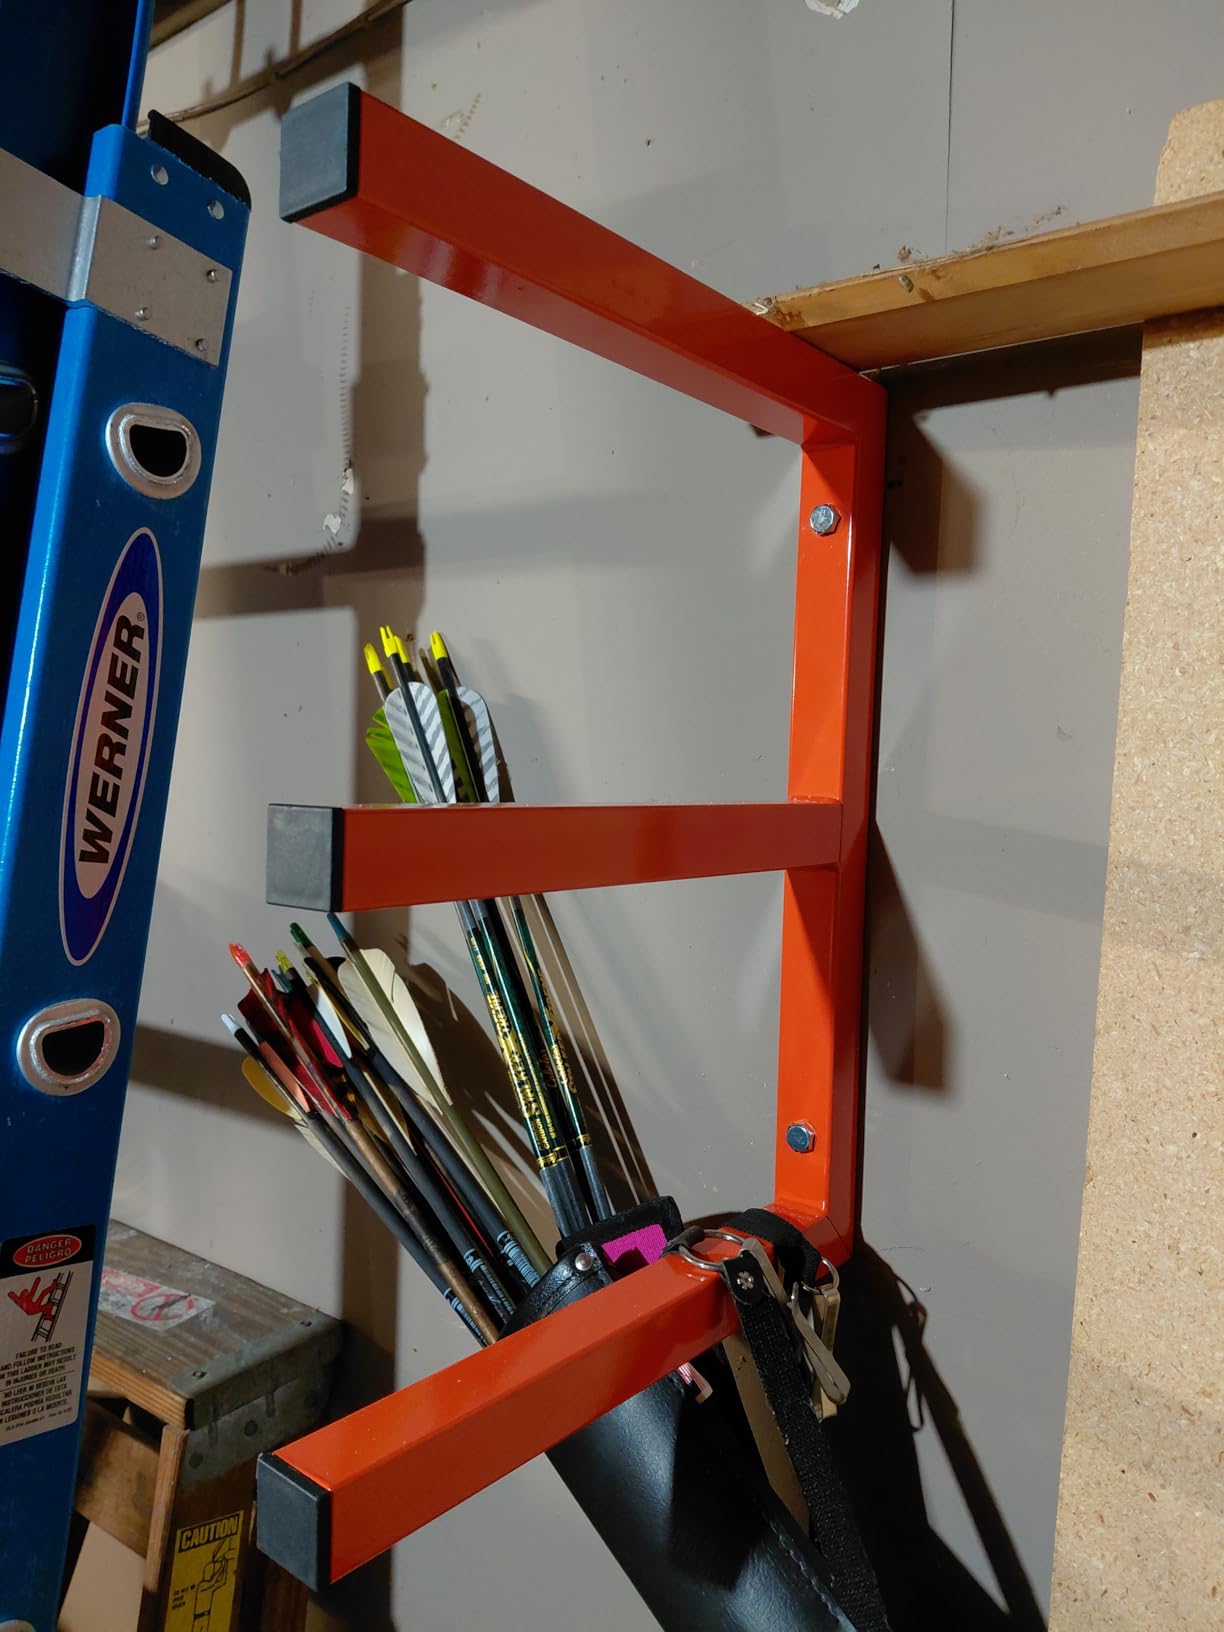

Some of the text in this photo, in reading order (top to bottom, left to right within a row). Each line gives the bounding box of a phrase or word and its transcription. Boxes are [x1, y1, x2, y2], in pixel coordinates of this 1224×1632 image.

[78, 613, 145, 864] WERNER
[26, 1239, 71, 1253] DANGER
[24, 1248, 72, 1264] PELIGRO
[13, 1356, 36, 1368] FOLLOW
[20, 1364, 42, 1375] LADDER
[180, 1515, 238, 1550] CAUTION
